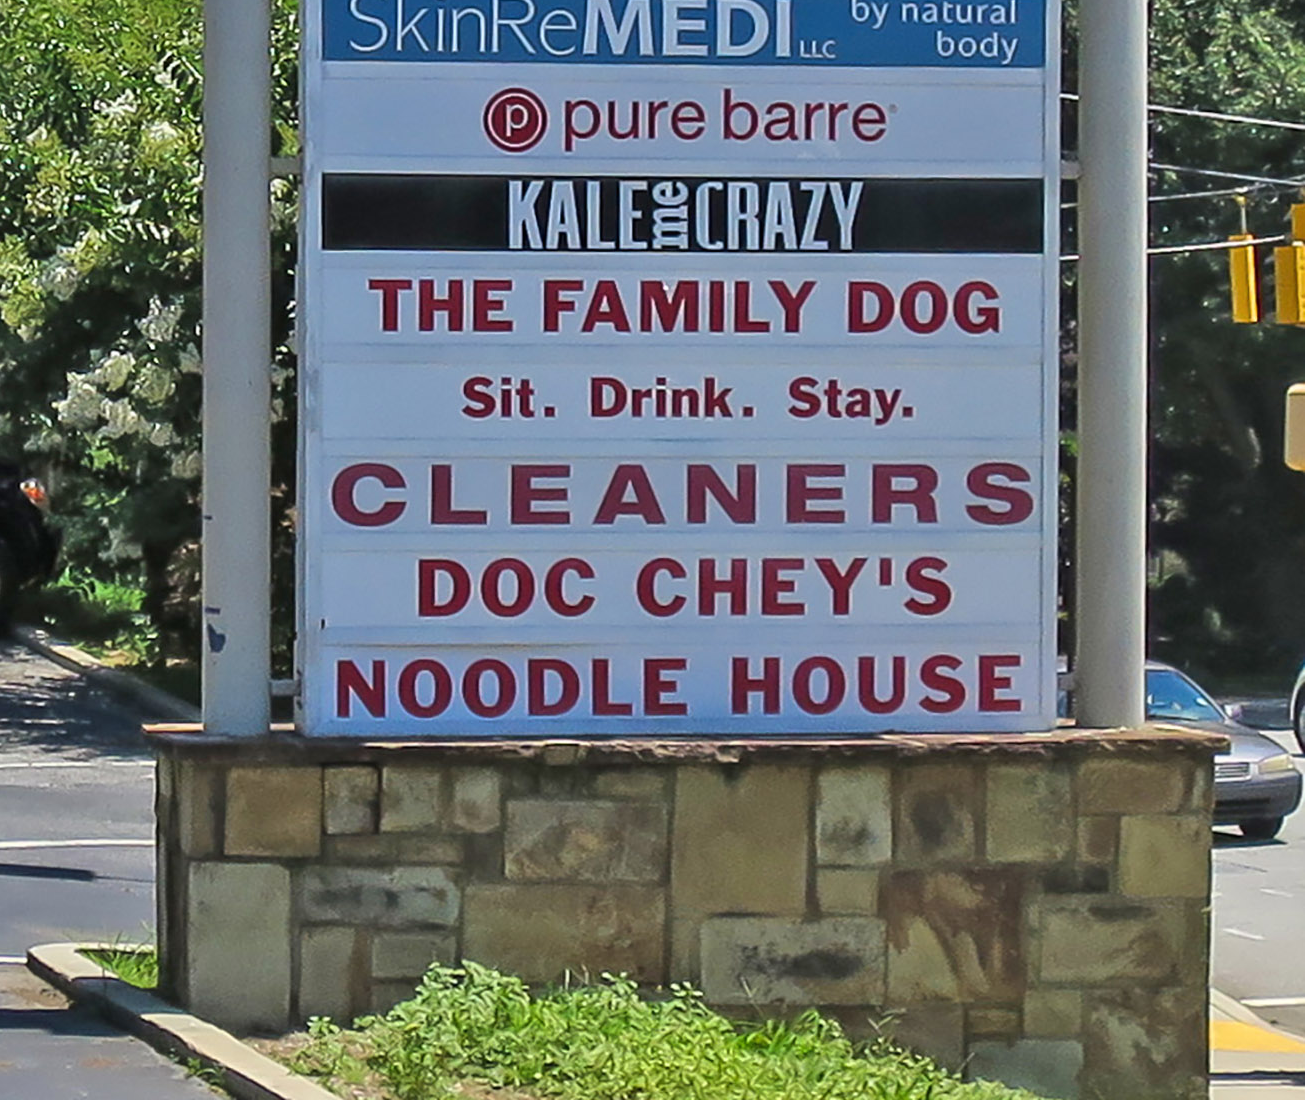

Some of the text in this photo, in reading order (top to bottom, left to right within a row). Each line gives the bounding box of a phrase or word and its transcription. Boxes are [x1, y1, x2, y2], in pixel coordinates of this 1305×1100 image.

[901, 0, 1016, 25] natural
[799, 39, 837, 60] LLC
[936, 29, 1018, 65] body
[562, 100, 708, 152] pure
[722, 88, 889, 143] barre
[508, 180, 864, 251] KALE me CRAZY
[368, 278, 1002, 334] THE FAMILY DOG
[461, 375, 915, 426] Sit. Drink. Stay.
[331, 460, 1035, 527] CLEANERS
[418, 555, 953, 617] DOC CHEY'S
[336, 652, 1025, 718] NOODLE HOUSE
